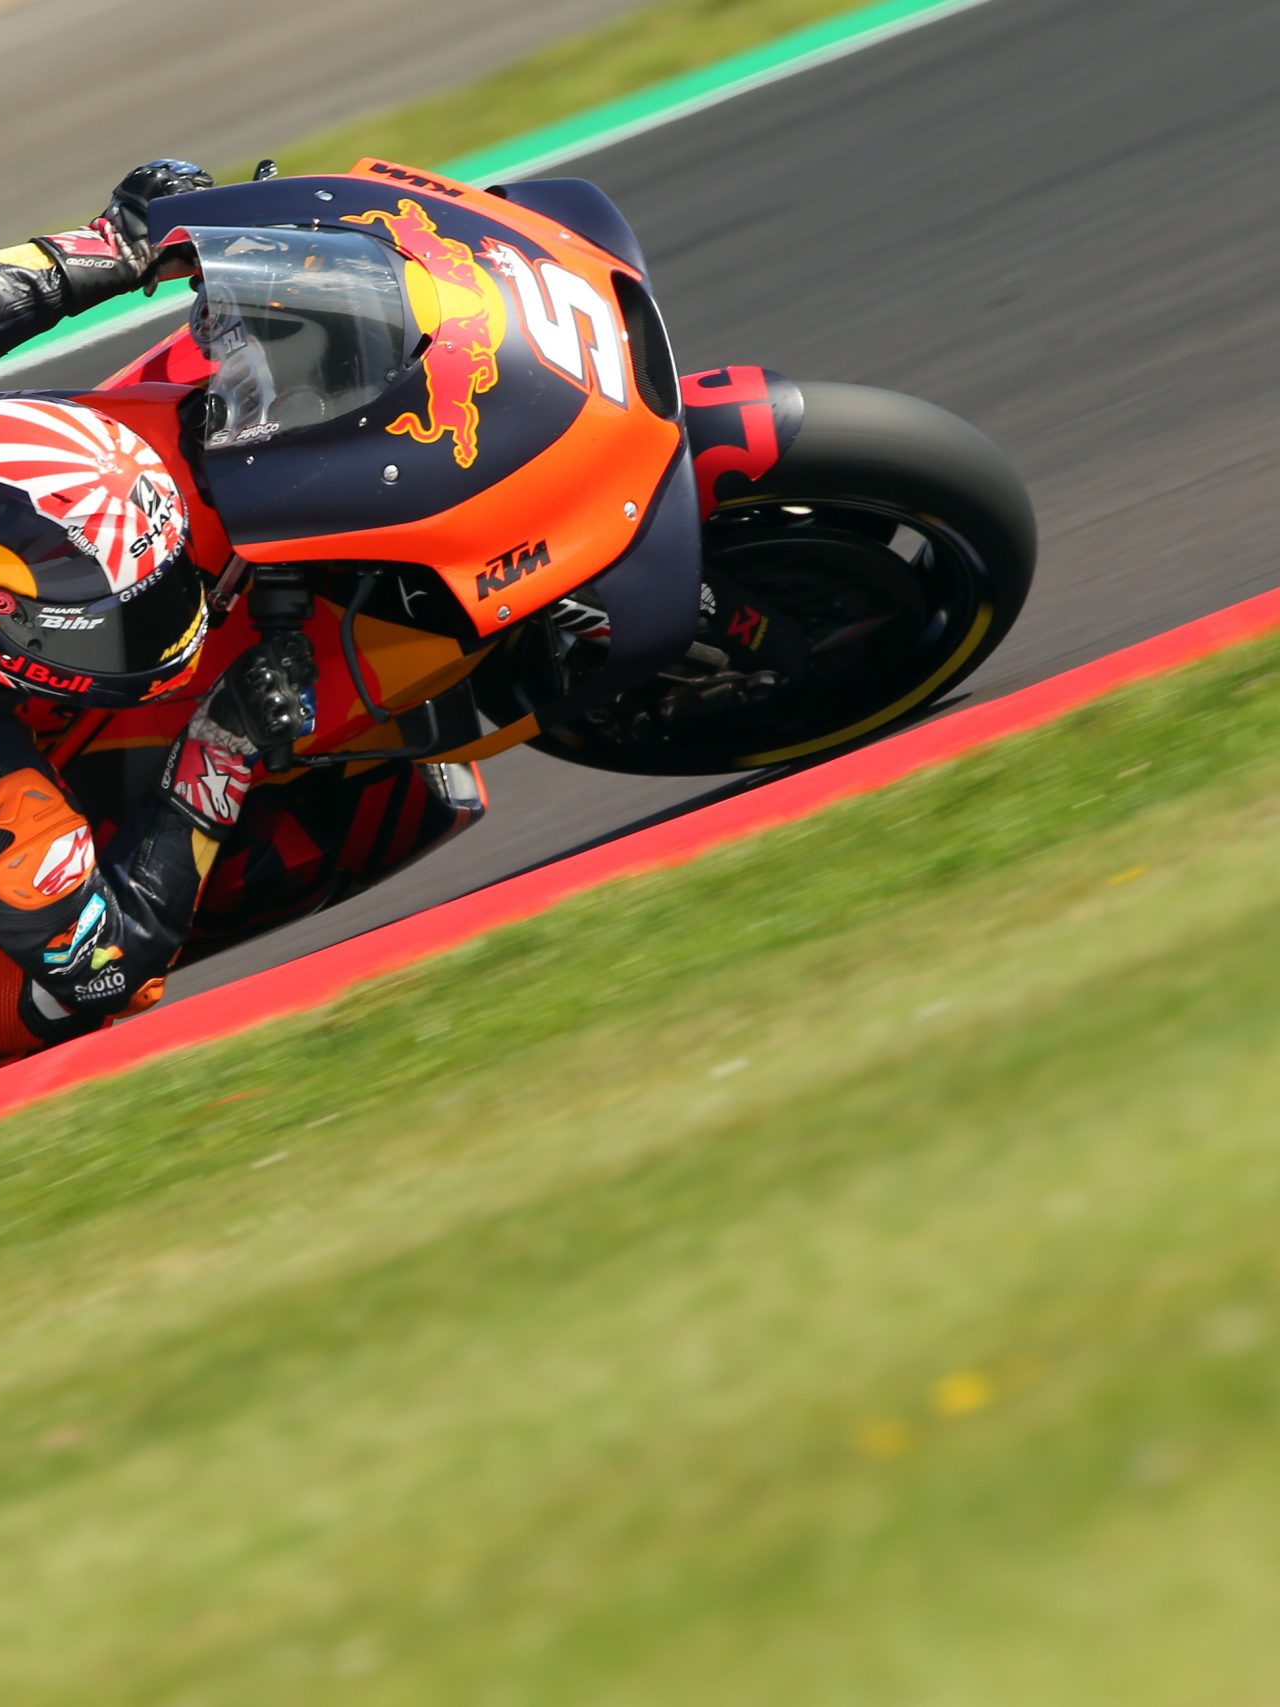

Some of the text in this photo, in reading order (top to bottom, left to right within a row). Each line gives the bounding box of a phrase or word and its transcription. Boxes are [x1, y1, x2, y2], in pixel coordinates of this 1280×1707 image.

[369, 163, 464, 198] KTM
[482, 243, 628, 408] 5
[120, 567, 164, 602] GIVES
[476, 539, 551, 602] KTM
[37, 613, 105, 631] Bihr
[41, 606, 86, 615] SHARK
[24, 662, 94, 693] Bull
